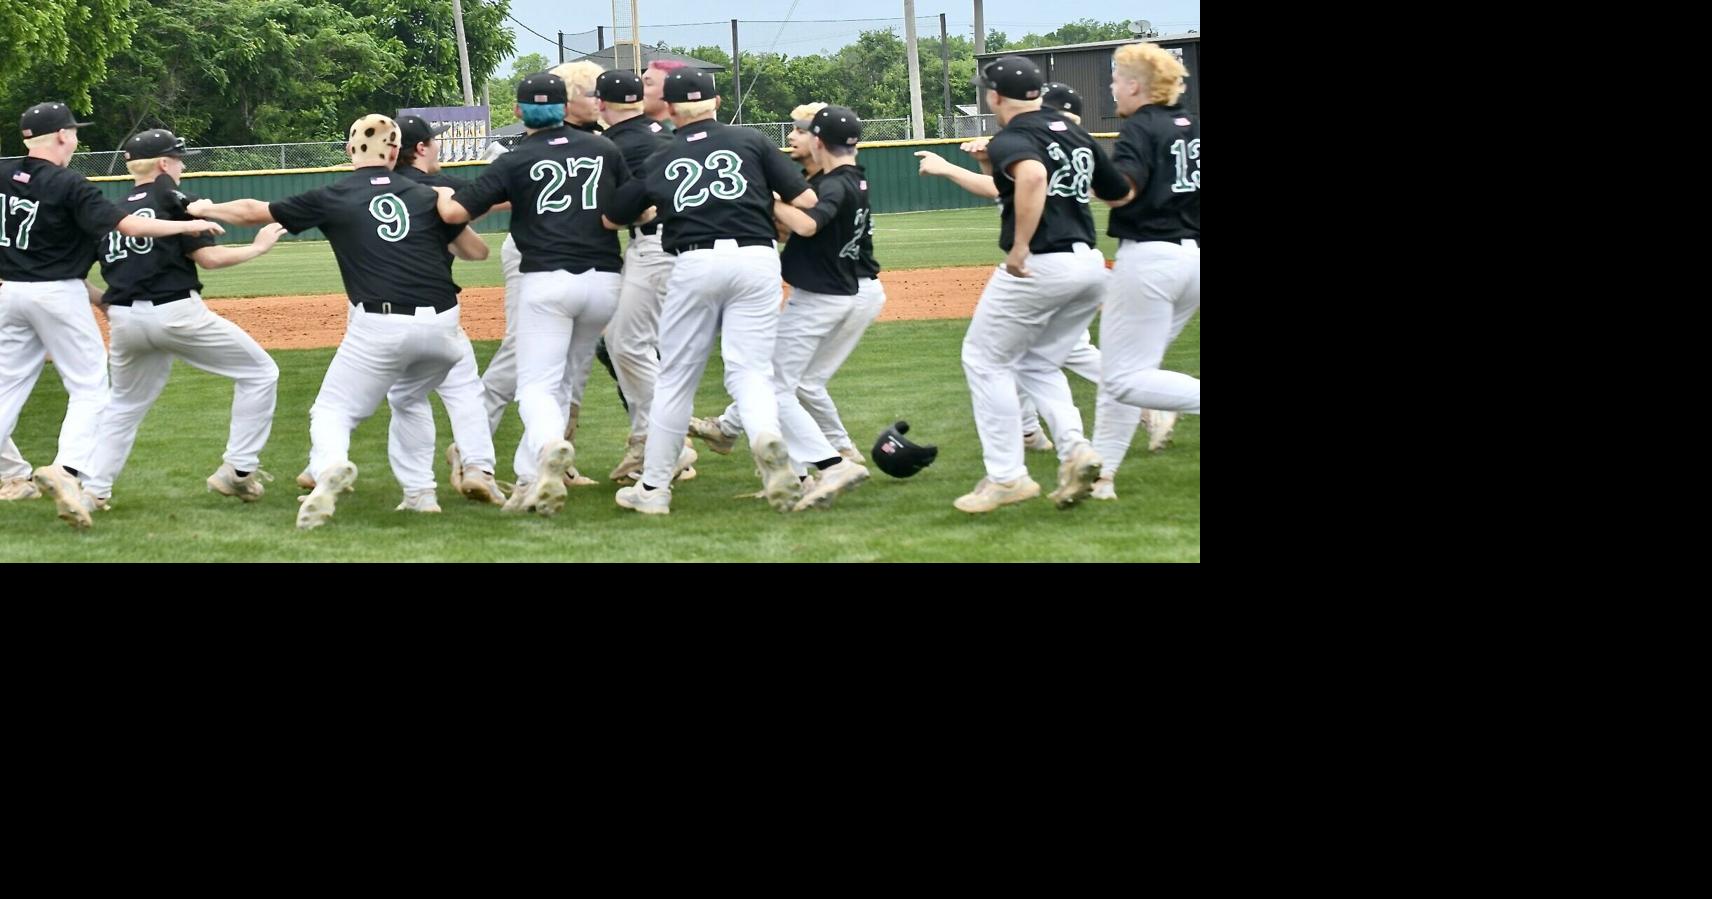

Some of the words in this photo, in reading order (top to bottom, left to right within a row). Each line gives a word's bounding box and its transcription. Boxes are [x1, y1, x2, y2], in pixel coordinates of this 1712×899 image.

[529, 156, 603, 214] 27
[664, 150, 747, 213] 23
[1047, 141, 1095, 203] 28
[369, 192, 410, 242] 9
